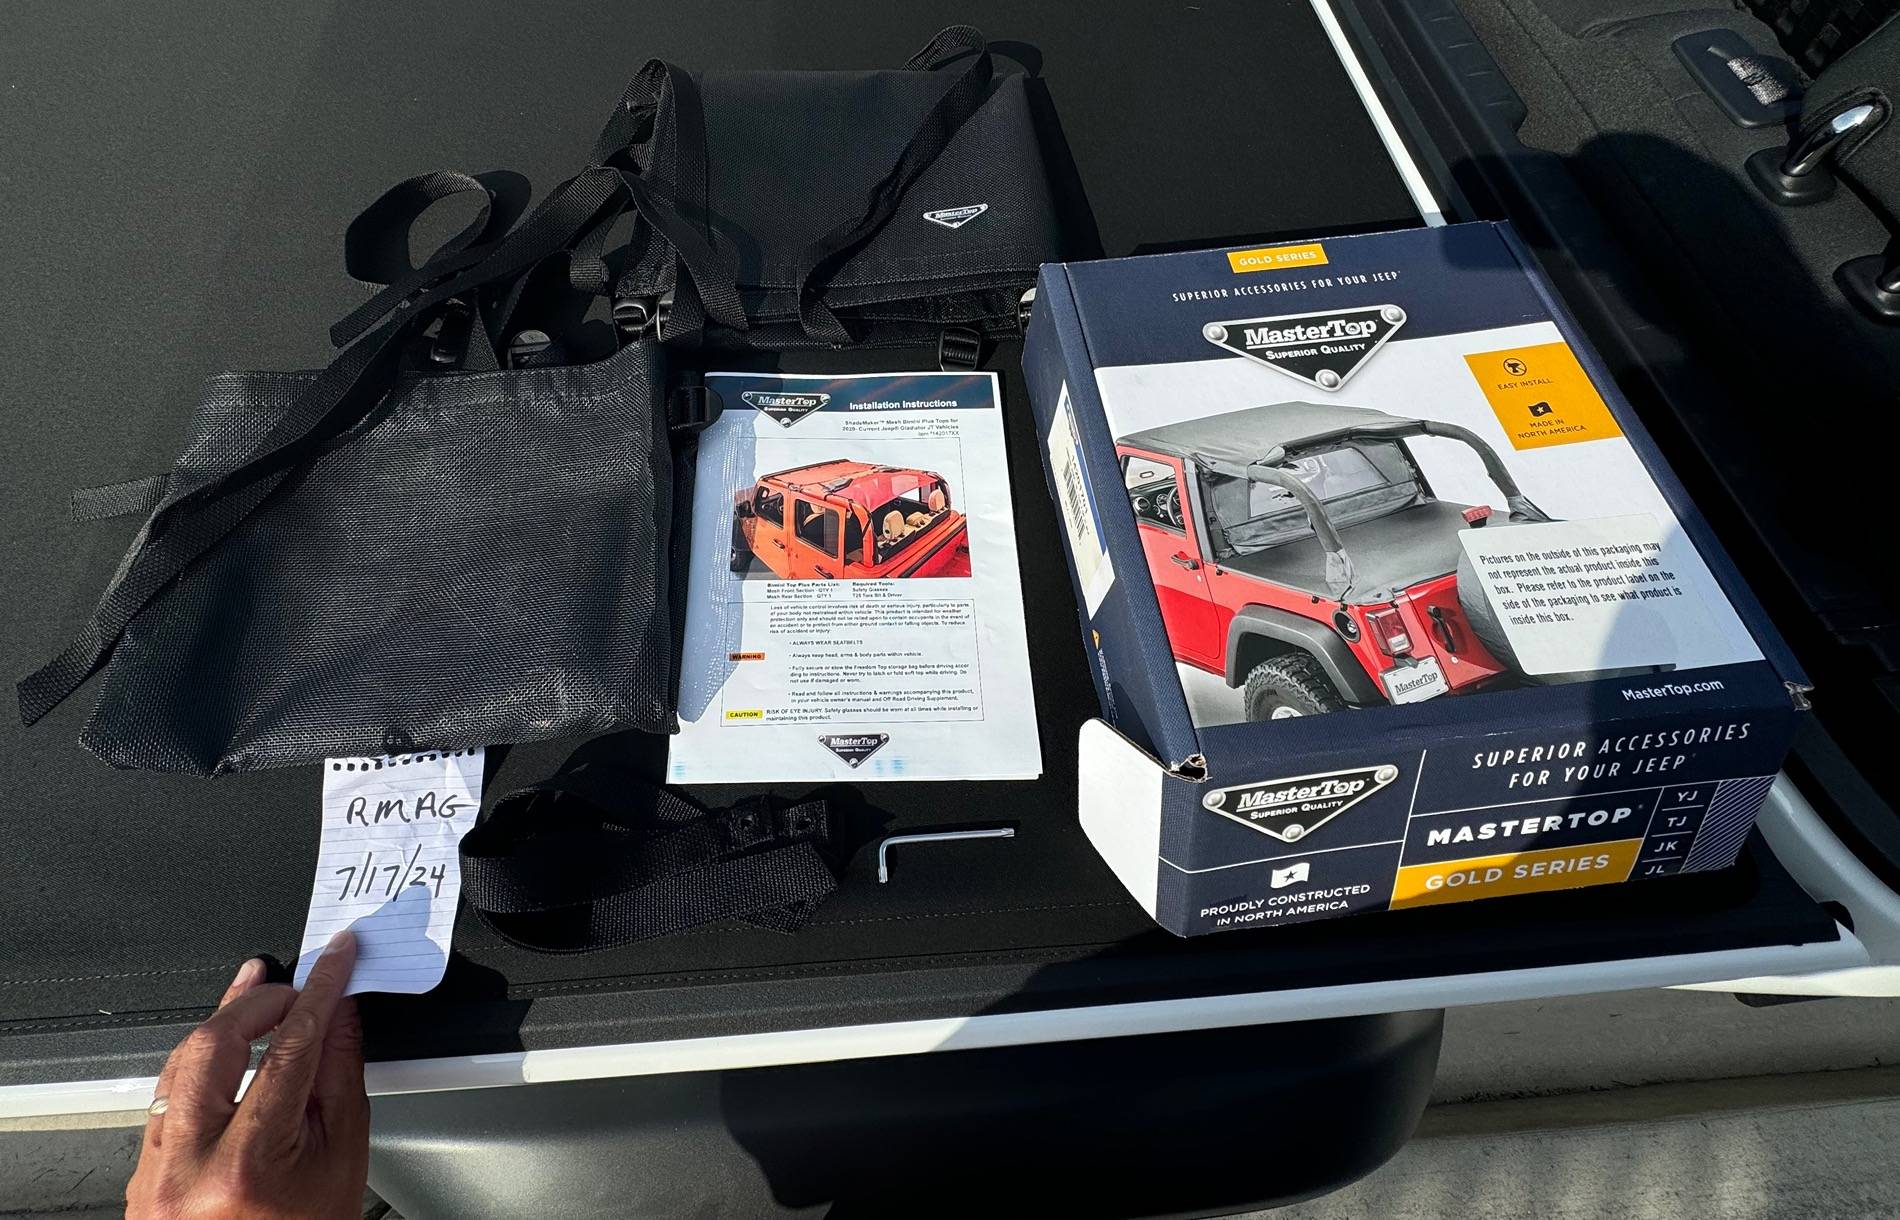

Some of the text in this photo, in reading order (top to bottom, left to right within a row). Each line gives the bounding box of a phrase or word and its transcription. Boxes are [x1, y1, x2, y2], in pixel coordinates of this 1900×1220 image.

[1239, 250, 1317, 267] GOLD SERIES
[1172, 288, 1228, 302] SUPERIOR
[1234, 280, 1307, 296] ACCESSORIES
[1312, 276, 1333, 289] FOR
[1337, 273, 1368, 286] YOUR
[1245, 319, 1378, 346] MasterTop
[1266, 343, 1366, 361] SUPERIOR QUALITY
[1498, 378, 1553, 391] EASY INSTALL
[758, 395, 817, 406] MasterTop
[849, 399, 958, 411] Installation Instructions
[1518, 425, 1586, 439] NORTH AMERICA
[1529, 419, 1553, 428] MADE
[1479, 542, 1662, 566] Pictures on the outside of this packaging may
[1488, 556, 1660, 580] not represent the actual product inside this
[1494, 570, 1676, 595] box. Please refer to the product label on the
[1502, 586, 1682, 611] side of the packaging to see what product is
[1509, 611, 1574, 626] inside this box.
[1394, 671, 1438, 694] MasterTop
[1621, 679, 1724, 701] MasterTop.com
[830, 736, 878, 747] MasterTop
[1472, 722, 1751, 769] SUPERIOR ACCESSORIES
[1508, 769, 1550, 789] FOR
[1563, 761, 1621, 782] YOUR
[1237, 778, 1366, 808] MasterTop
[1677, 790, 1698, 803] YJ
[346, 791, 478, 827] RMAG
[1250, 800, 1344, 820] SUPERIOR QUALITY
[1426, 807, 1632, 847] MASTERTOP
[1667, 815, 1687, 828] TJ
[1654, 839, 1678, 852] JK
[335, 843, 446, 902] 7/17/24
[1426, 854, 1610, 891] GOLD SERIES
[1644, 864, 1665, 876] JL
[1200, 884, 1371, 918] PROUDLY CONSTRUCTED
[1216, 900, 1349, 927] IN NORTH AMERICA
